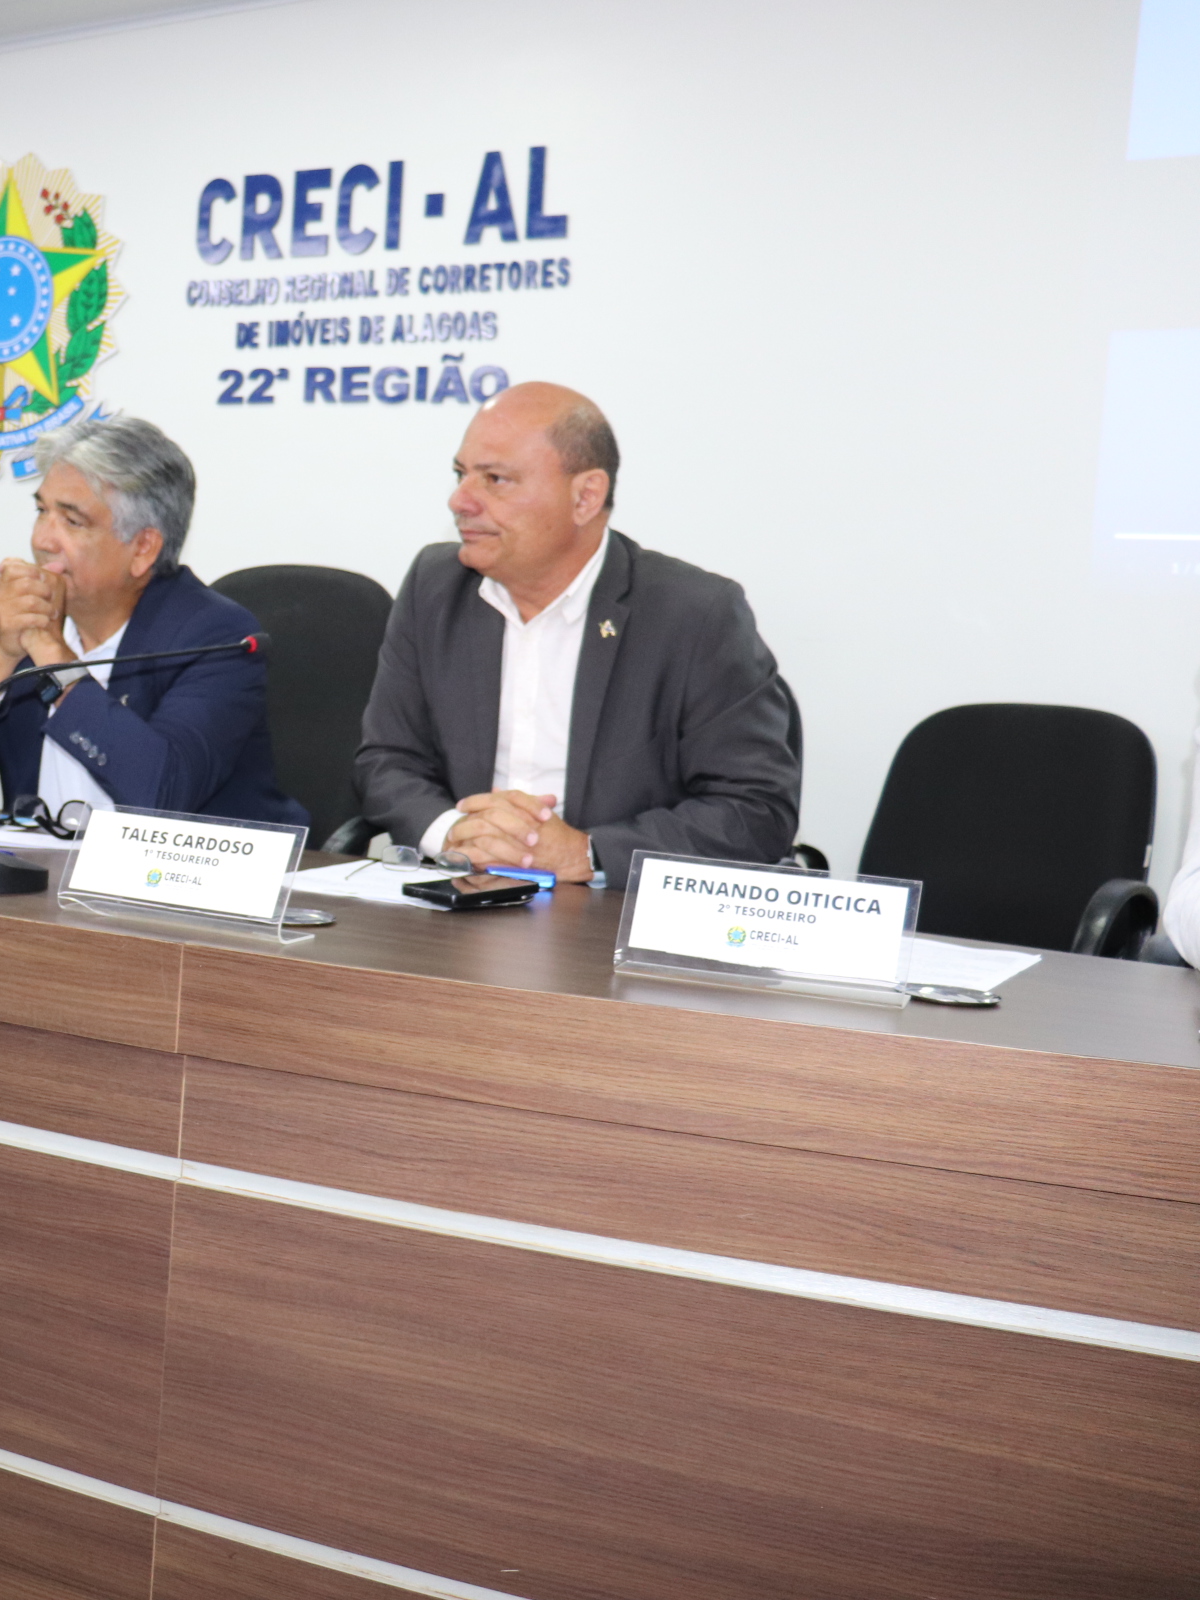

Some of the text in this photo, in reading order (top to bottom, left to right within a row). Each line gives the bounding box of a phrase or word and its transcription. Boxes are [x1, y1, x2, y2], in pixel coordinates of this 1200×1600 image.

[196, 160, 404, 265] CRECI
[463, 146, 569, 245] AL
[187, 258, 571, 307] CONSELHO REGIONAL DE CORRETORES
[236, 311, 498, 349] DE IMÓVEIS DE ALAGOAS
[303, 352, 511, 405] REGIÃO
[120, 825, 255, 856] TALES CARDOSO
[155, 849, 220, 867] TESOUREIRO
[163, 871, 203, 887] CRECI-AL
[662, 875, 883, 916] FERNANDO OITICICA
[734, 904, 818, 925] TESOUREIRO
[749, 929, 800, 946] CRECI-AL
